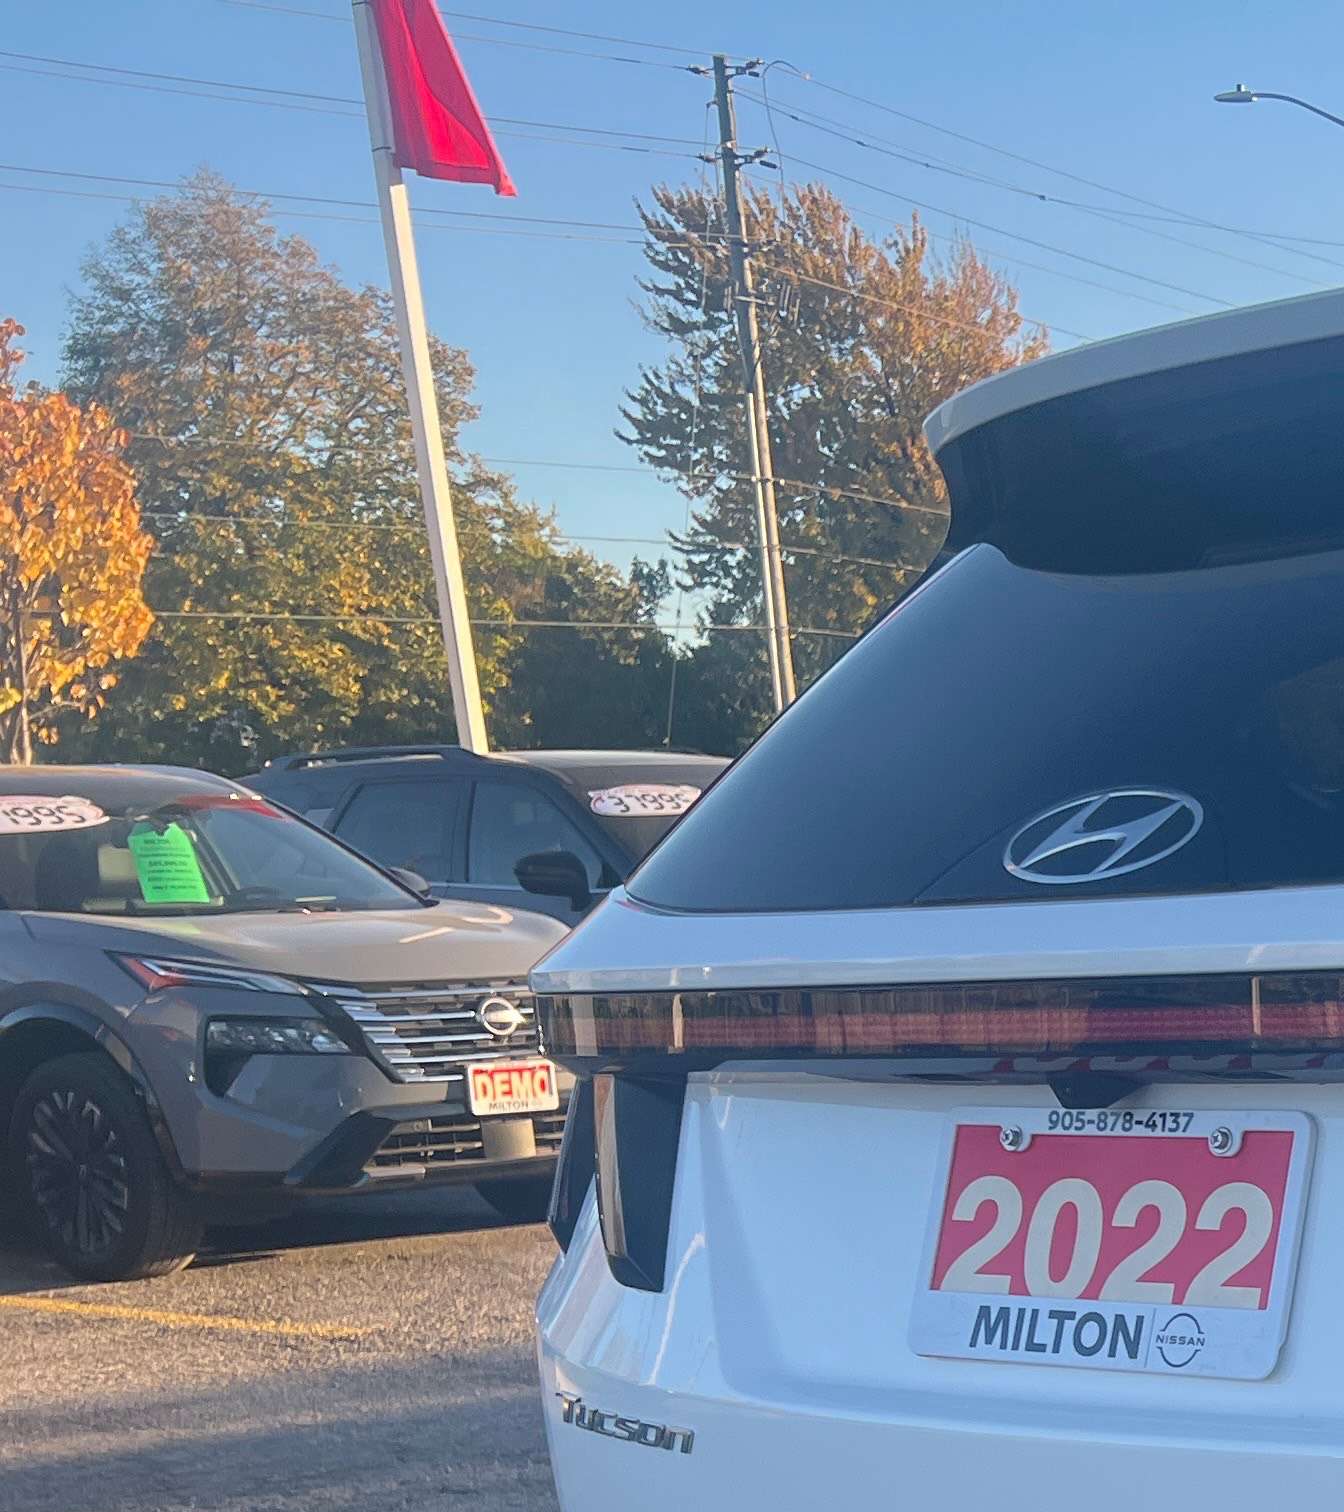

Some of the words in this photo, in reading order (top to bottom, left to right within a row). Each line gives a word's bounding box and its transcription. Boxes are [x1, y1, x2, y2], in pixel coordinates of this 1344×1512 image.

[474, 1070, 551, 1101] DEMO
[1047, 1109, 1195, 1133] 905-878-4137
[939, 1175, 1274, 1310] 2022
[968, 1304, 1146, 1360] MILTON
[1155, 1333, 1206, 1348] NISSAN
